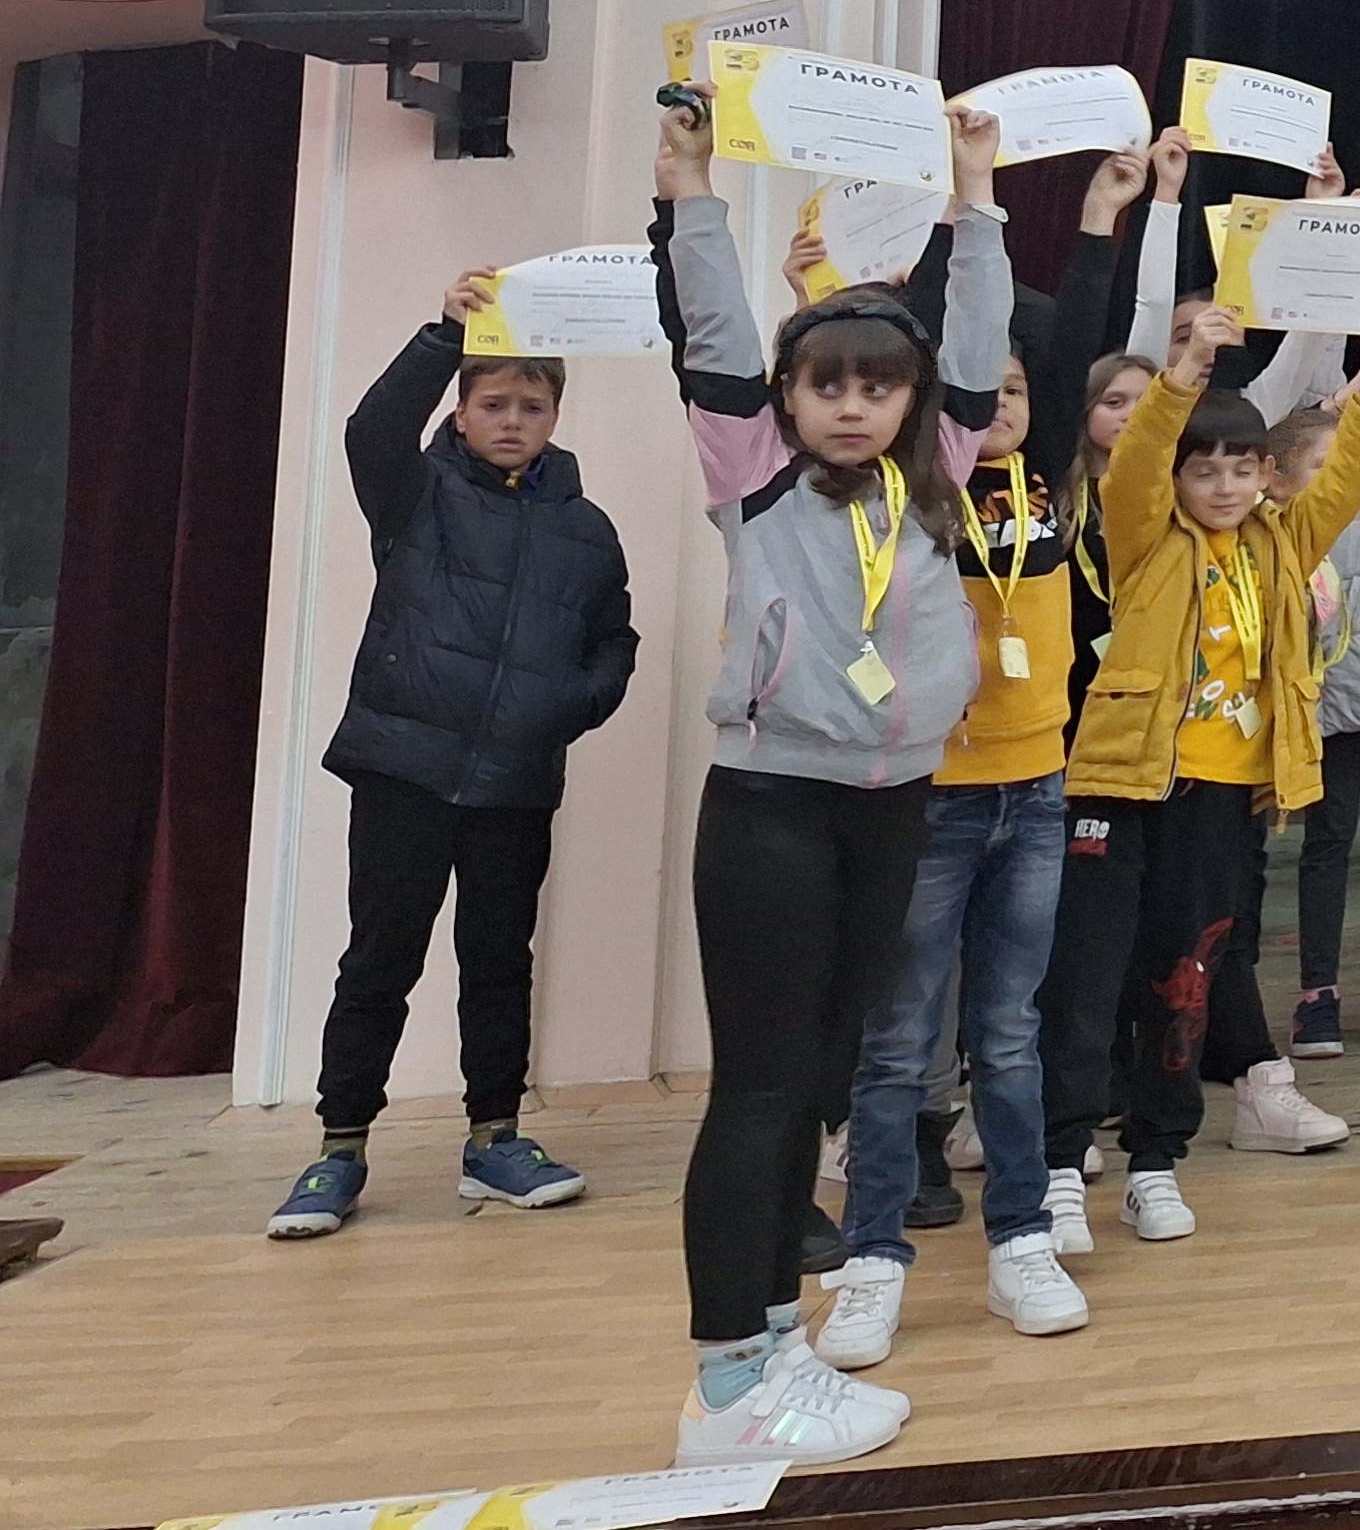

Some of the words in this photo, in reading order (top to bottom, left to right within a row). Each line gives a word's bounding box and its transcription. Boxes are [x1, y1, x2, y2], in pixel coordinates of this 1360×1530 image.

[714, 16, 790, 40] ГРАМОТА
[801, 63, 920, 95] ГРАМОТА
[1242, 78, 1316, 106] ГРАМОТА
[549, 254, 653, 266] ГРАМОТА
